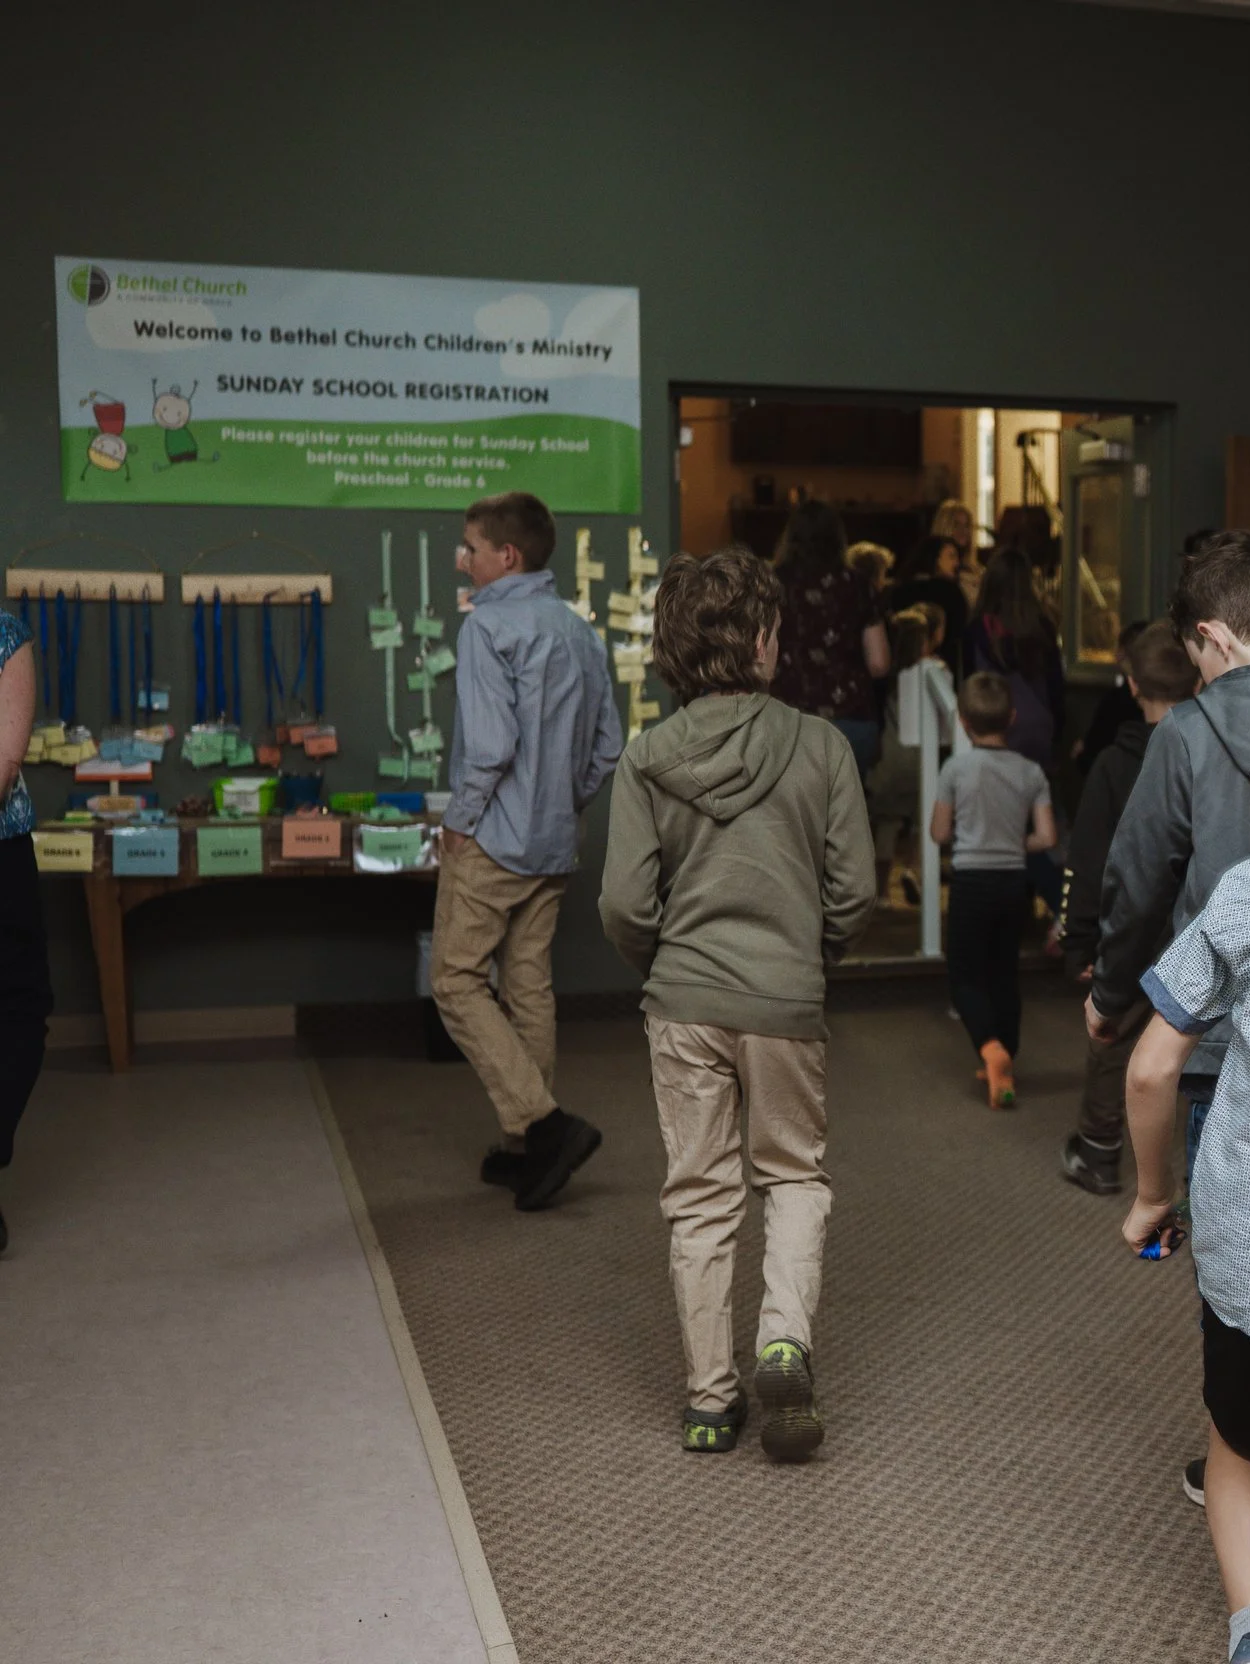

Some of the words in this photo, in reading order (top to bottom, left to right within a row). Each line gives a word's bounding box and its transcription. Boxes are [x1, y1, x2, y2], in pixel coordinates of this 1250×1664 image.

[117, 273, 178, 293] Bethel
[182, 276, 247, 297] Church
[133, 319, 233, 343] Welcome
[241, 324, 262, 343] to
[269, 326, 336, 347] Bethel
[345, 329, 416, 350] Church
[424, 332, 525, 355] Children's
[532, 338, 613, 363] Ministry
[217, 373, 304, 395] SUNDAY
[312, 377, 398, 399] SCHOOL
[405, 381, 549, 404] REGISTRATION
[221, 426, 274, 444] Please
[279, 429, 341, 447] register
[346, 433, 380, 448] your
[386, 431, 448, 449] children
[452, 433, 475, 449] for
[480, 435, 535, 455] Sunday
[540, 437, 590, 452] School
[306, 448, 358, 466] before
[363, 451, 389, 467] the
[394, 452, 446, 468] church
[334, 470, 410, 486] Preschool
[424, 473, 472, 489] Grade
